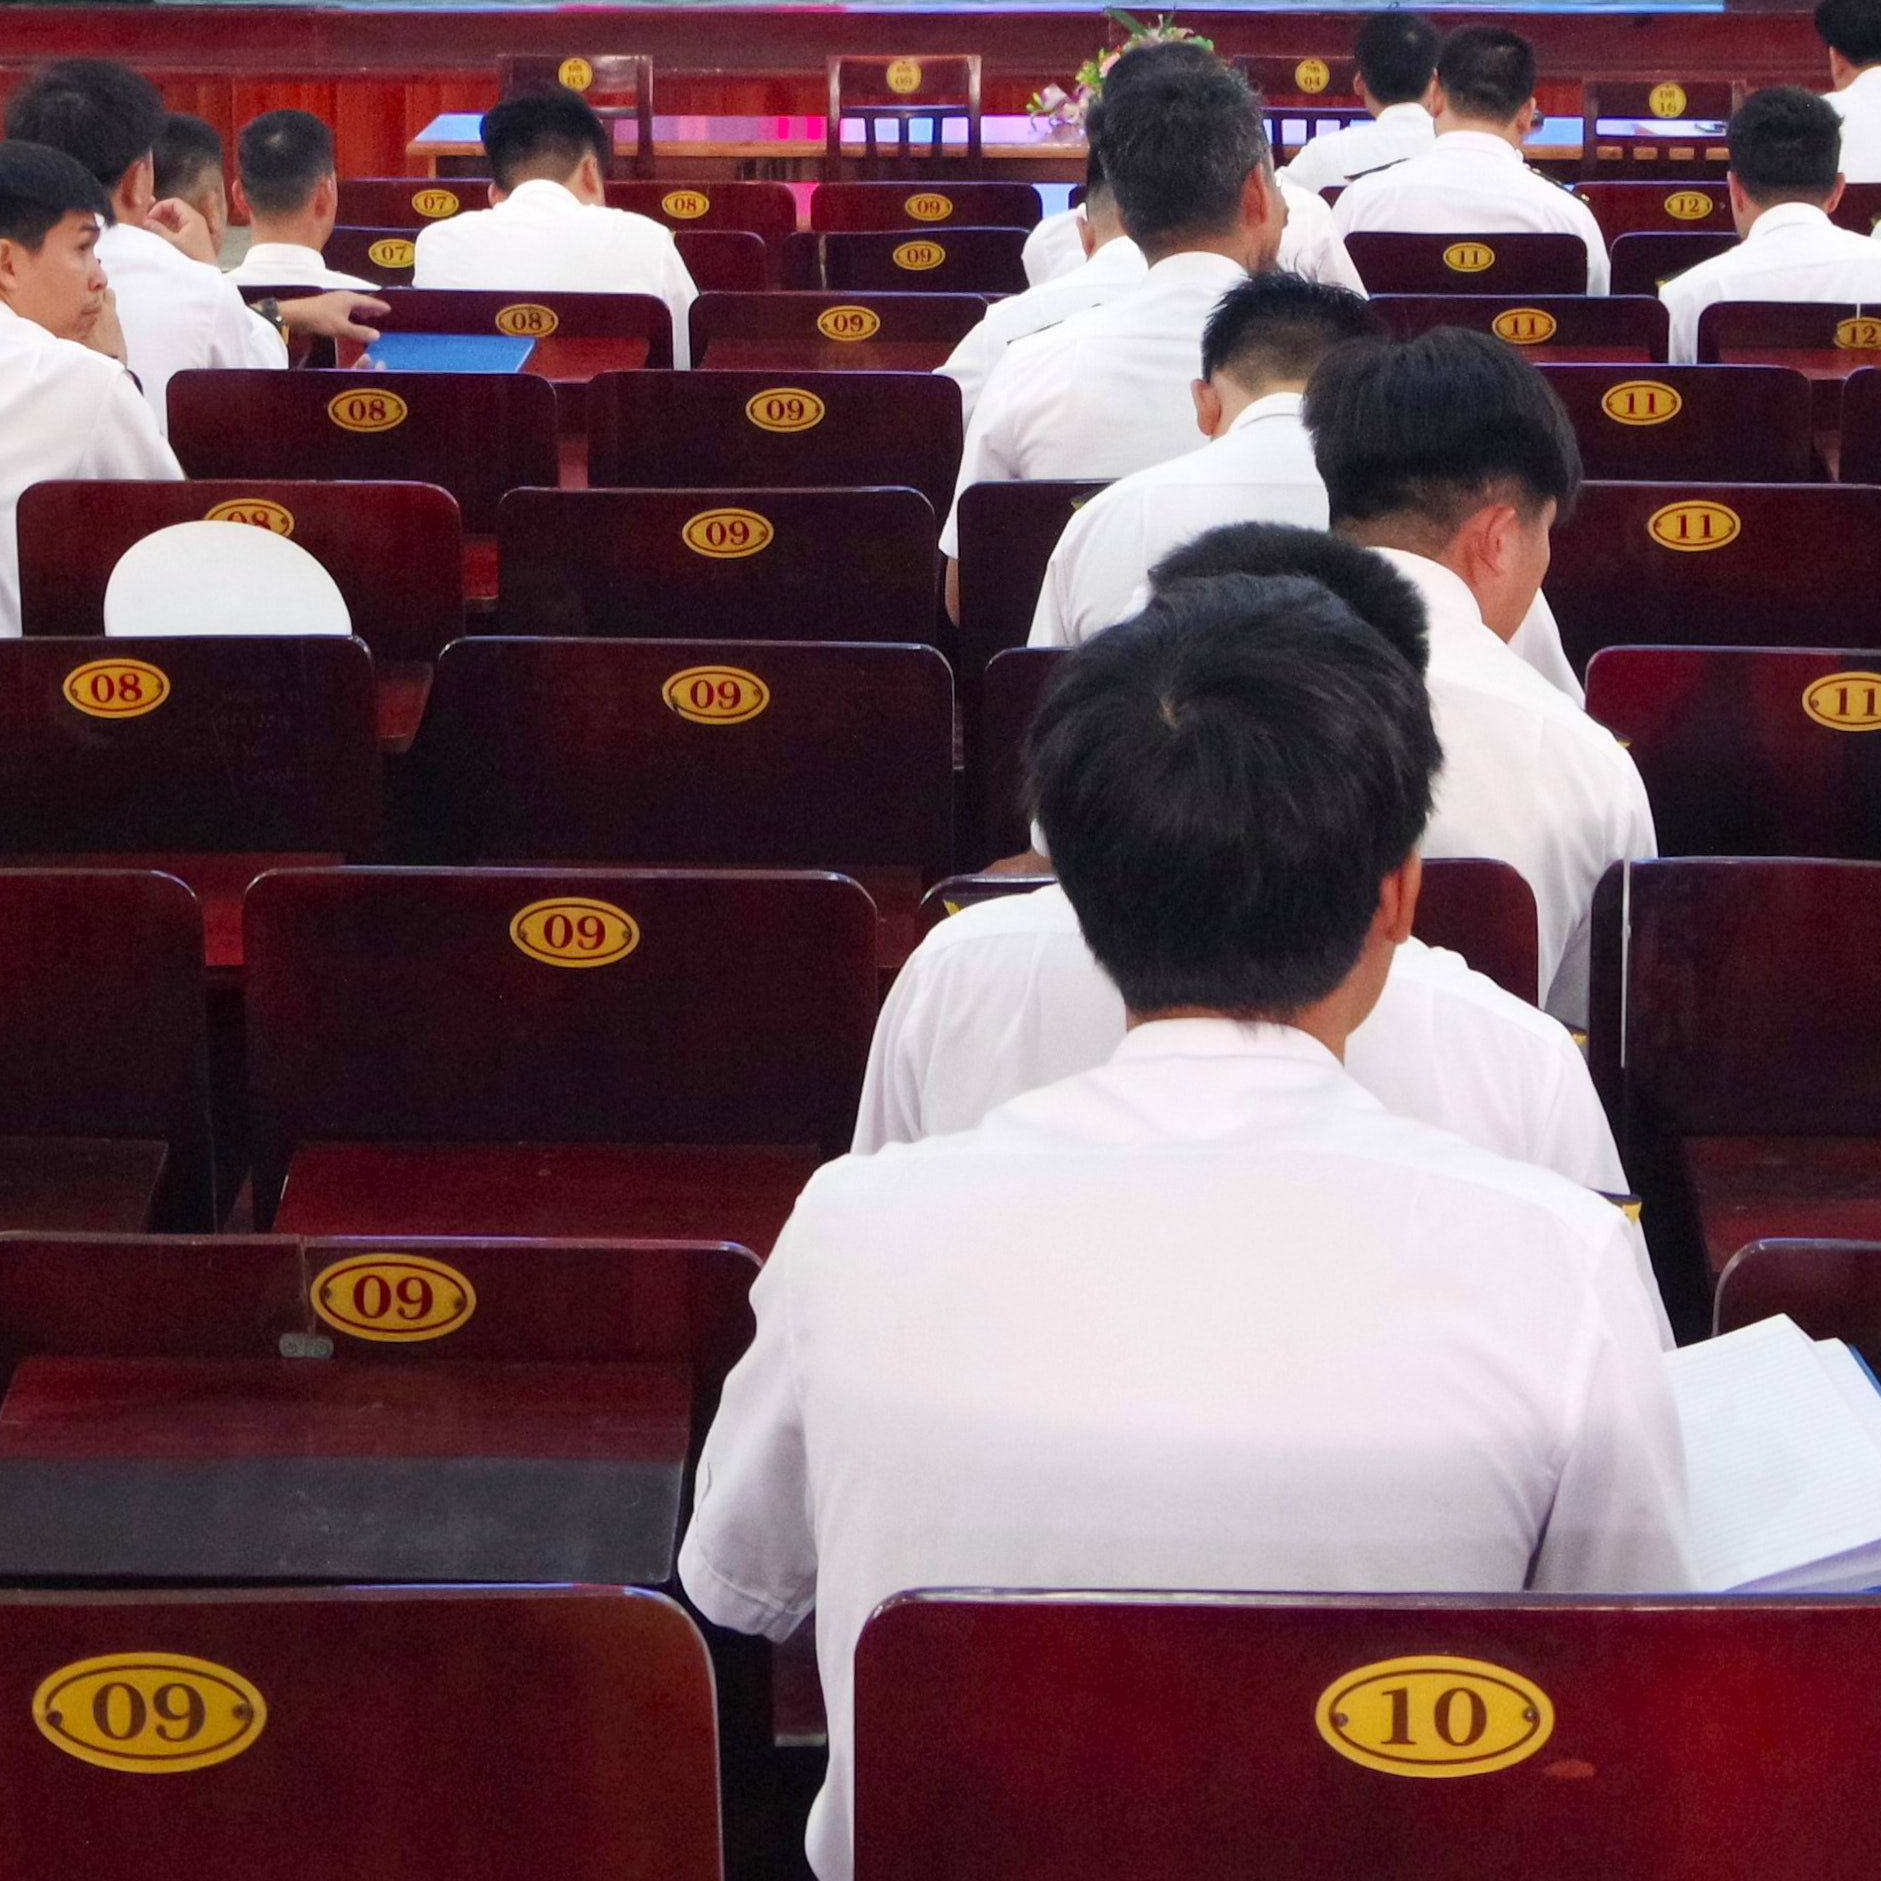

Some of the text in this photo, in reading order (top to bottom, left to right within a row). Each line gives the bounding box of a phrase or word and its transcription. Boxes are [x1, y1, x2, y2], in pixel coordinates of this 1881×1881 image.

[423, 194, 448, 211] 07
[674, 196, 698, 211] 08
[917, 199, 940, 215] 09
[1679, 197, 1699, 212] 12
[381, 246, 406, 261] 07
[906, 248, 932, 263] 09
[1460, 249, 1478, 265] 11
[511, 312, 541, 330] 08
[833, 313, 863, 331] 09
[1513, 316, 1536, 335] 11
[1851, 326, 1876, 344] 12
[347, 398, 386, 422] 08
[770, 398, 804, 421] 09
[1628, 392, 1655, 413] 11
[705, 521, 749, 547] 09
[1678, 514, 1712, 539] 11
[89, 672, 143, 704] 08
[689, 679, 742, 711] 09
[1834, 687, 1877, 718] 11
[542, 914, 605, 951] 09
[354, 1274, 434, 1320] 09
[93, 1681, 207, 1743] 09
[1379, 1686, 1489, 1747] 10
